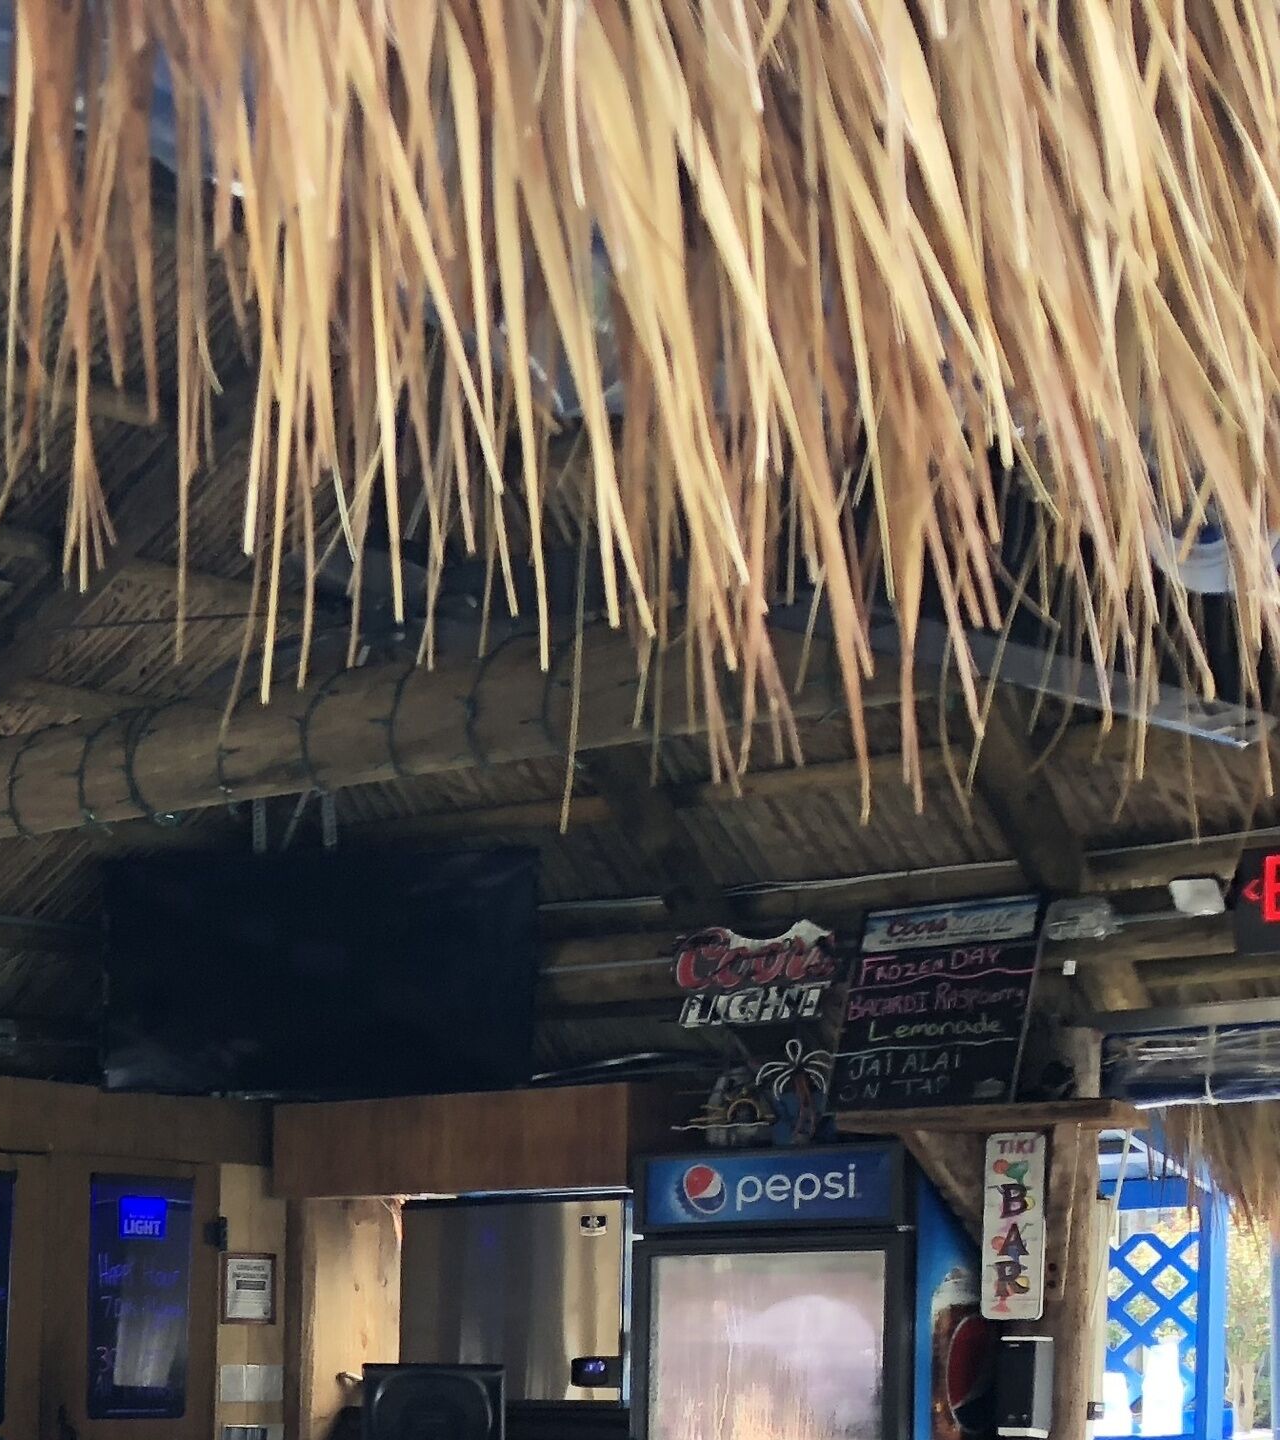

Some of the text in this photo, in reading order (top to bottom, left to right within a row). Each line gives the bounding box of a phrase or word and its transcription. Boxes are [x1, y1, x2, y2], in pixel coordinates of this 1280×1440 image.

[887, 916, 948, 937] Coors
[950, 947, 1001, 969] DAY
[678, 981, 832, 1029] LIGHT
[868, 1014, 1005, 1041] Lemonade
[849, 1047, 962, 1080] JAI ALAI
[995, 1139, 1036, 1155] TIKI
[735, 1164, 857, 1210] pepsi
[123, 1219, 162, 1237] LIGHT
[993, 1183, 1034, 1298] BAR
